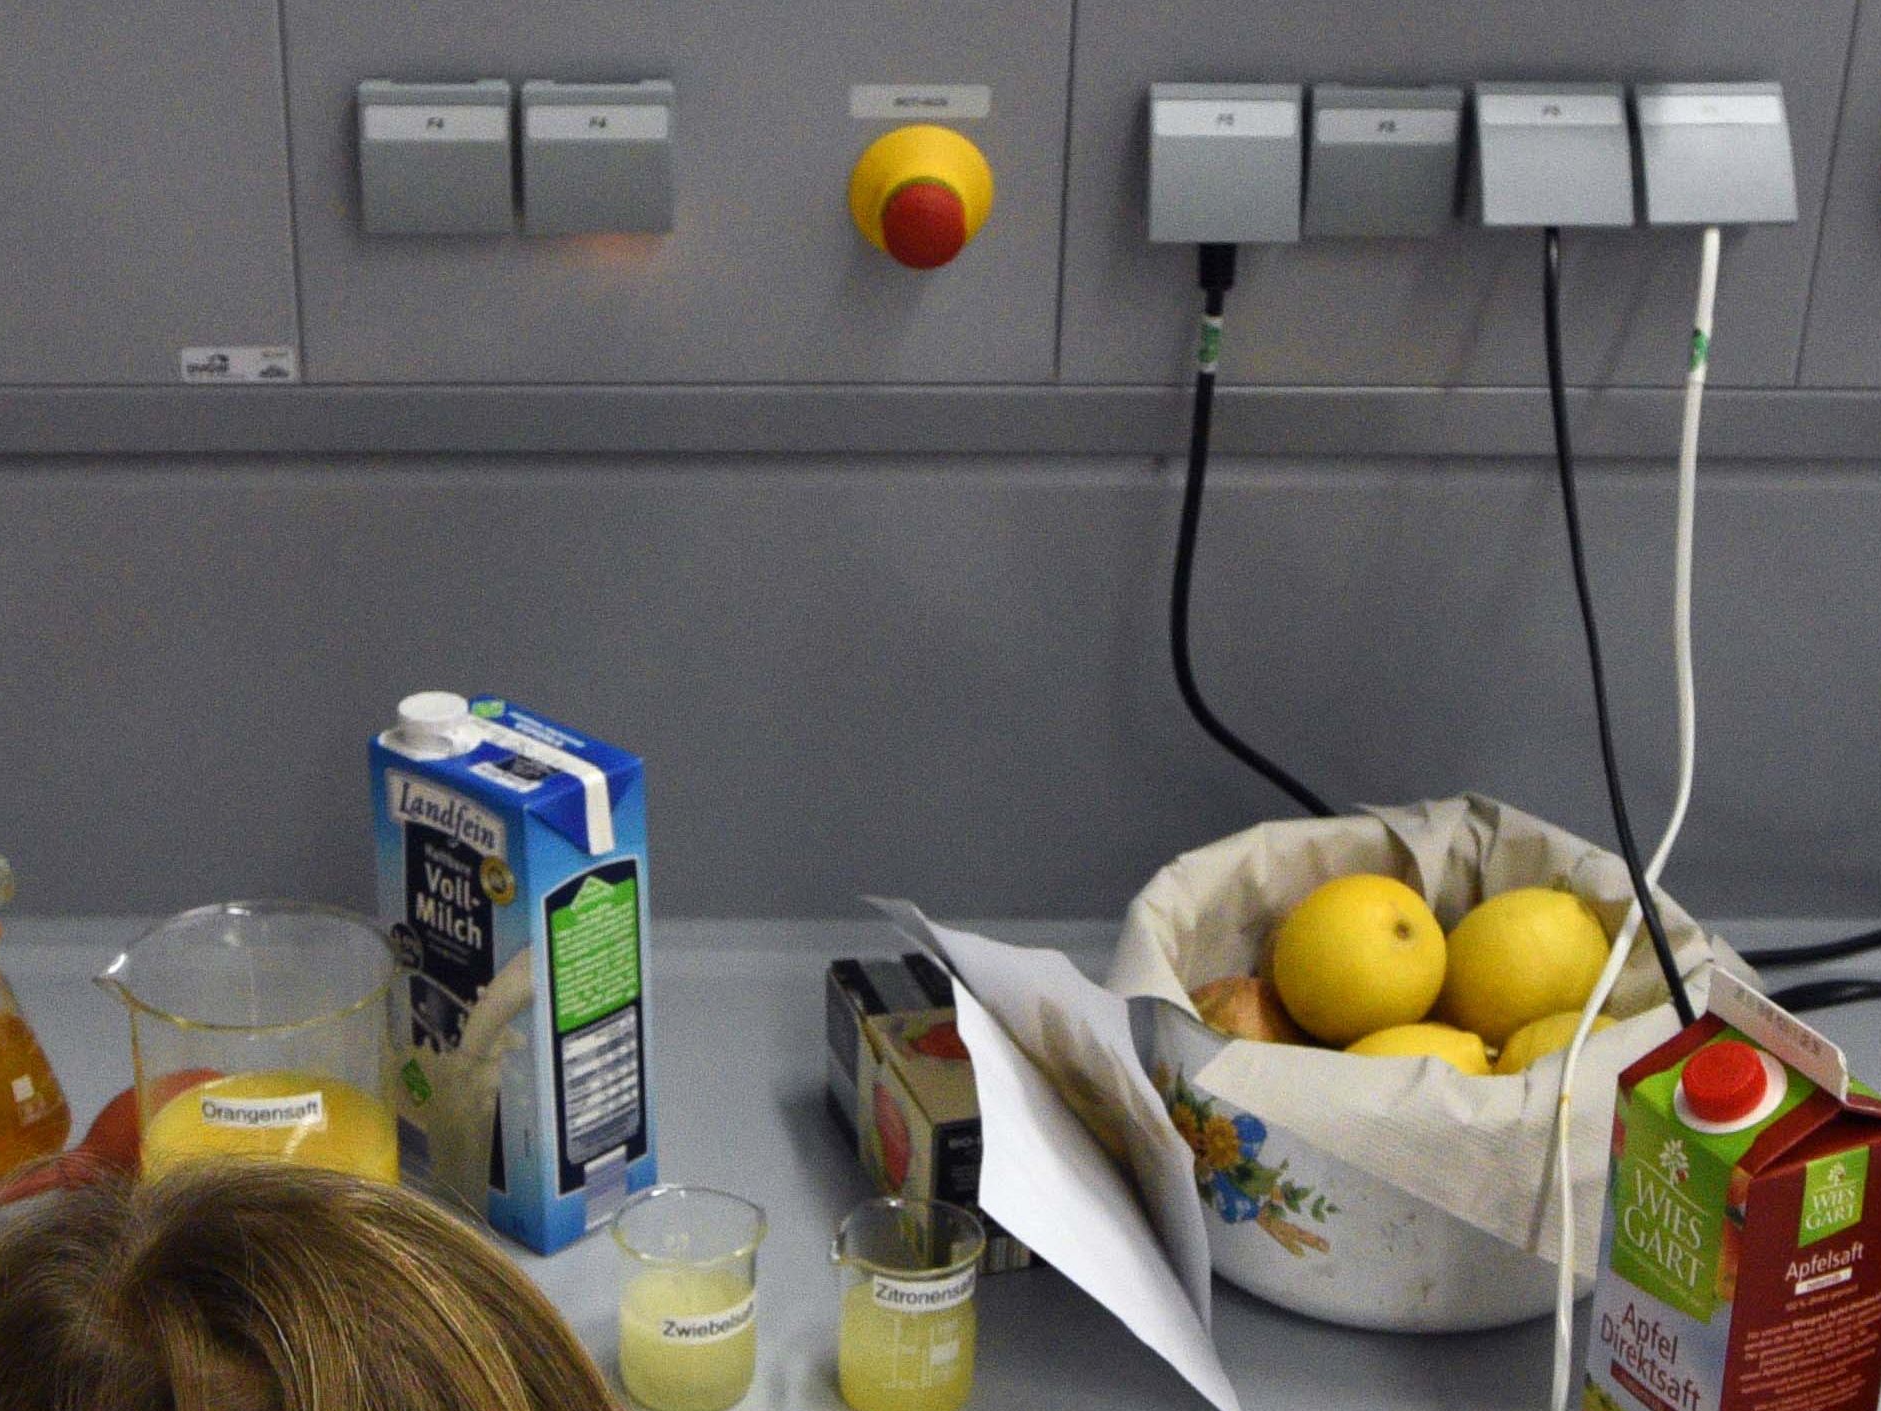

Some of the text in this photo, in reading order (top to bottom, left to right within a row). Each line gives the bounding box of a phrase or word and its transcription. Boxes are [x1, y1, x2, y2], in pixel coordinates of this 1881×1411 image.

[399, 782, 497, 849] Landfein
[424, 861, 481, 912] Voll-
[415, 889, 483, 951] Milch
[201, 1100, 318, 1125] Orangensaft
[1635, 1169, 1703, 1250] WIES
[1805, 1203, 1855, 1231] GART
[1812, 1186, 1857, 1212] WIES
[1624, 1206, 1706, 1287] GART
[1784, 1241, 1865, 1284] Apfelsaft
[1621, 1302, 1679, 1365] Apfel
